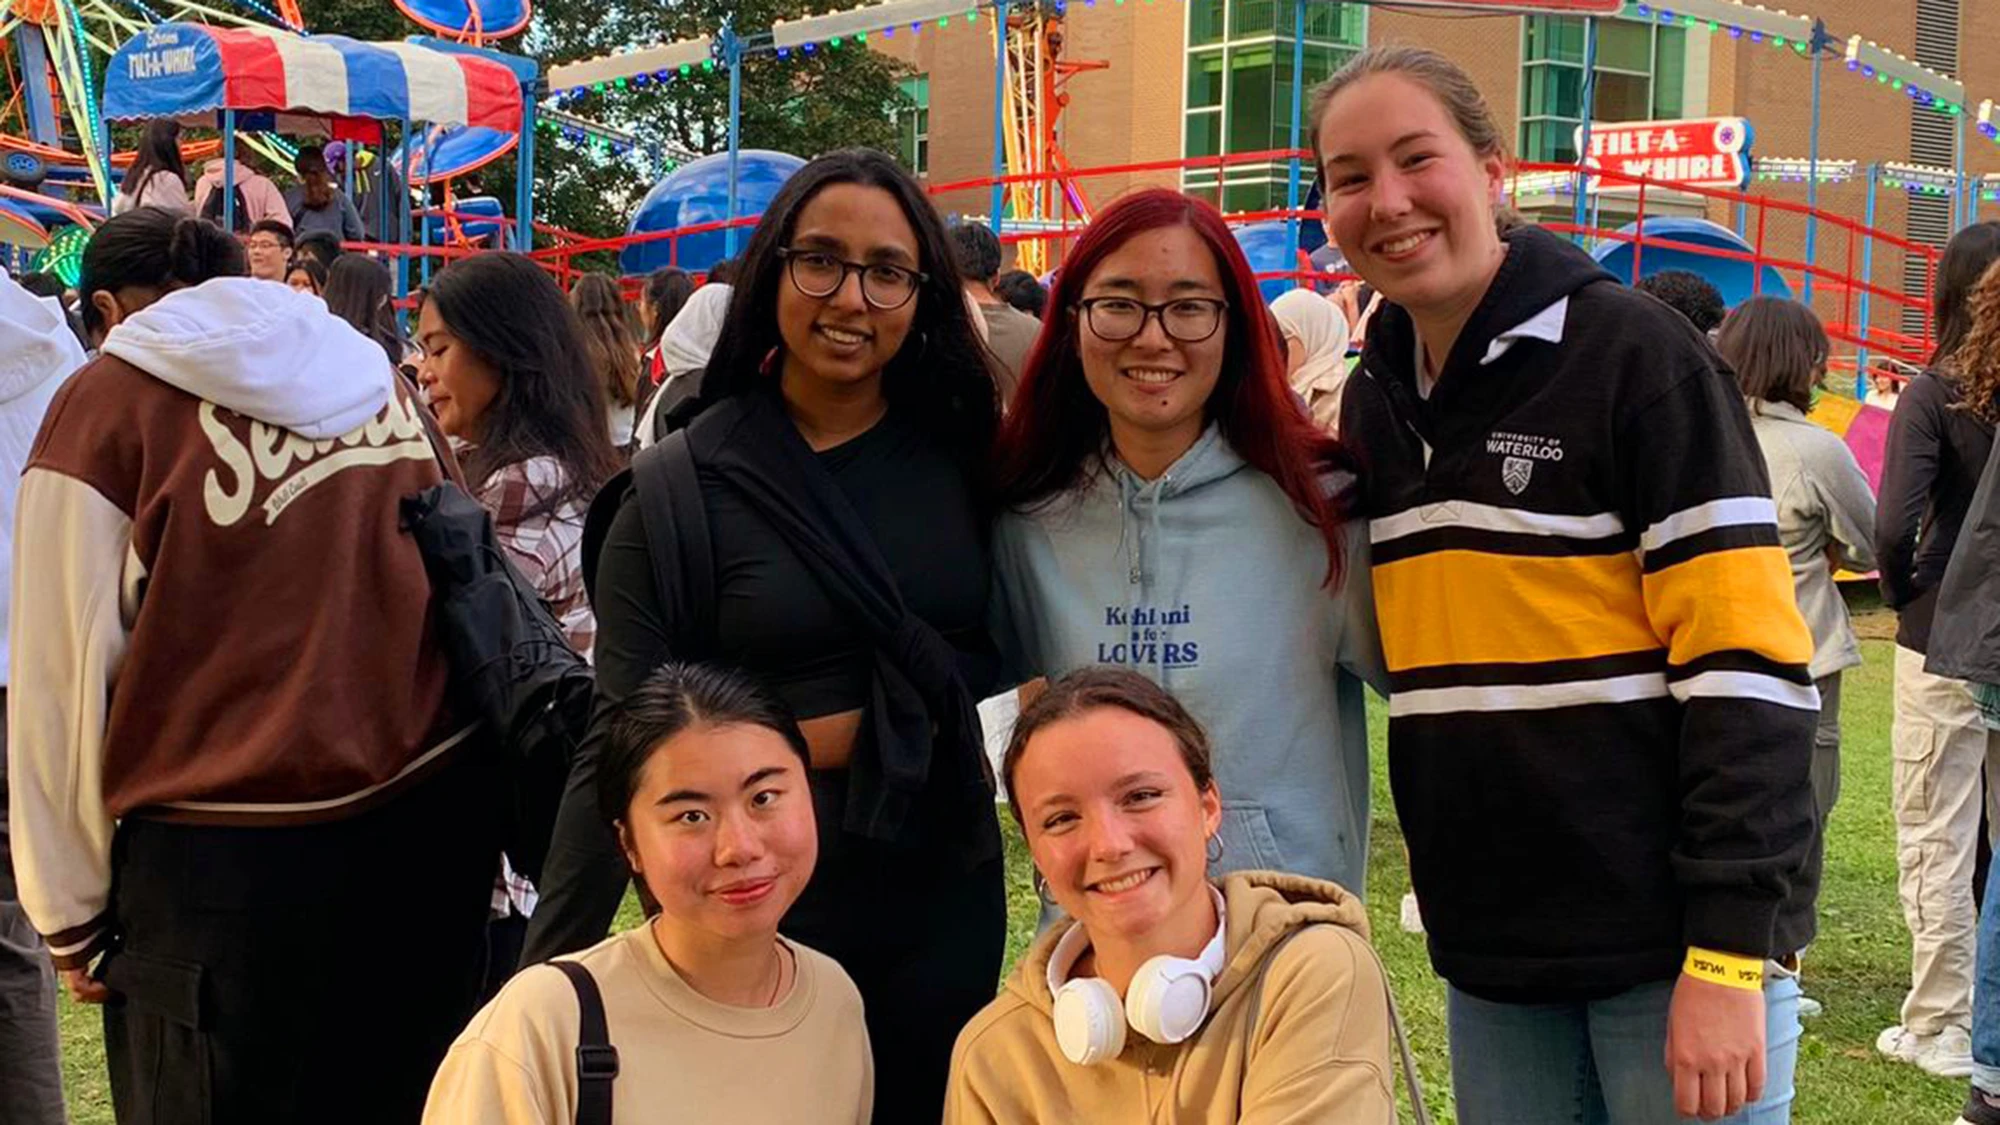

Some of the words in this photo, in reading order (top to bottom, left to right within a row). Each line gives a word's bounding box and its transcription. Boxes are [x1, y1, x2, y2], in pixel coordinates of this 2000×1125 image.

[1623, 153, 1727, 181] WHIRL
[1486, 440, 1563, 461] WATERLOO
[1098, 642, 1198, 663] LOVERS
[1738, 969, 1761, 982] USA
